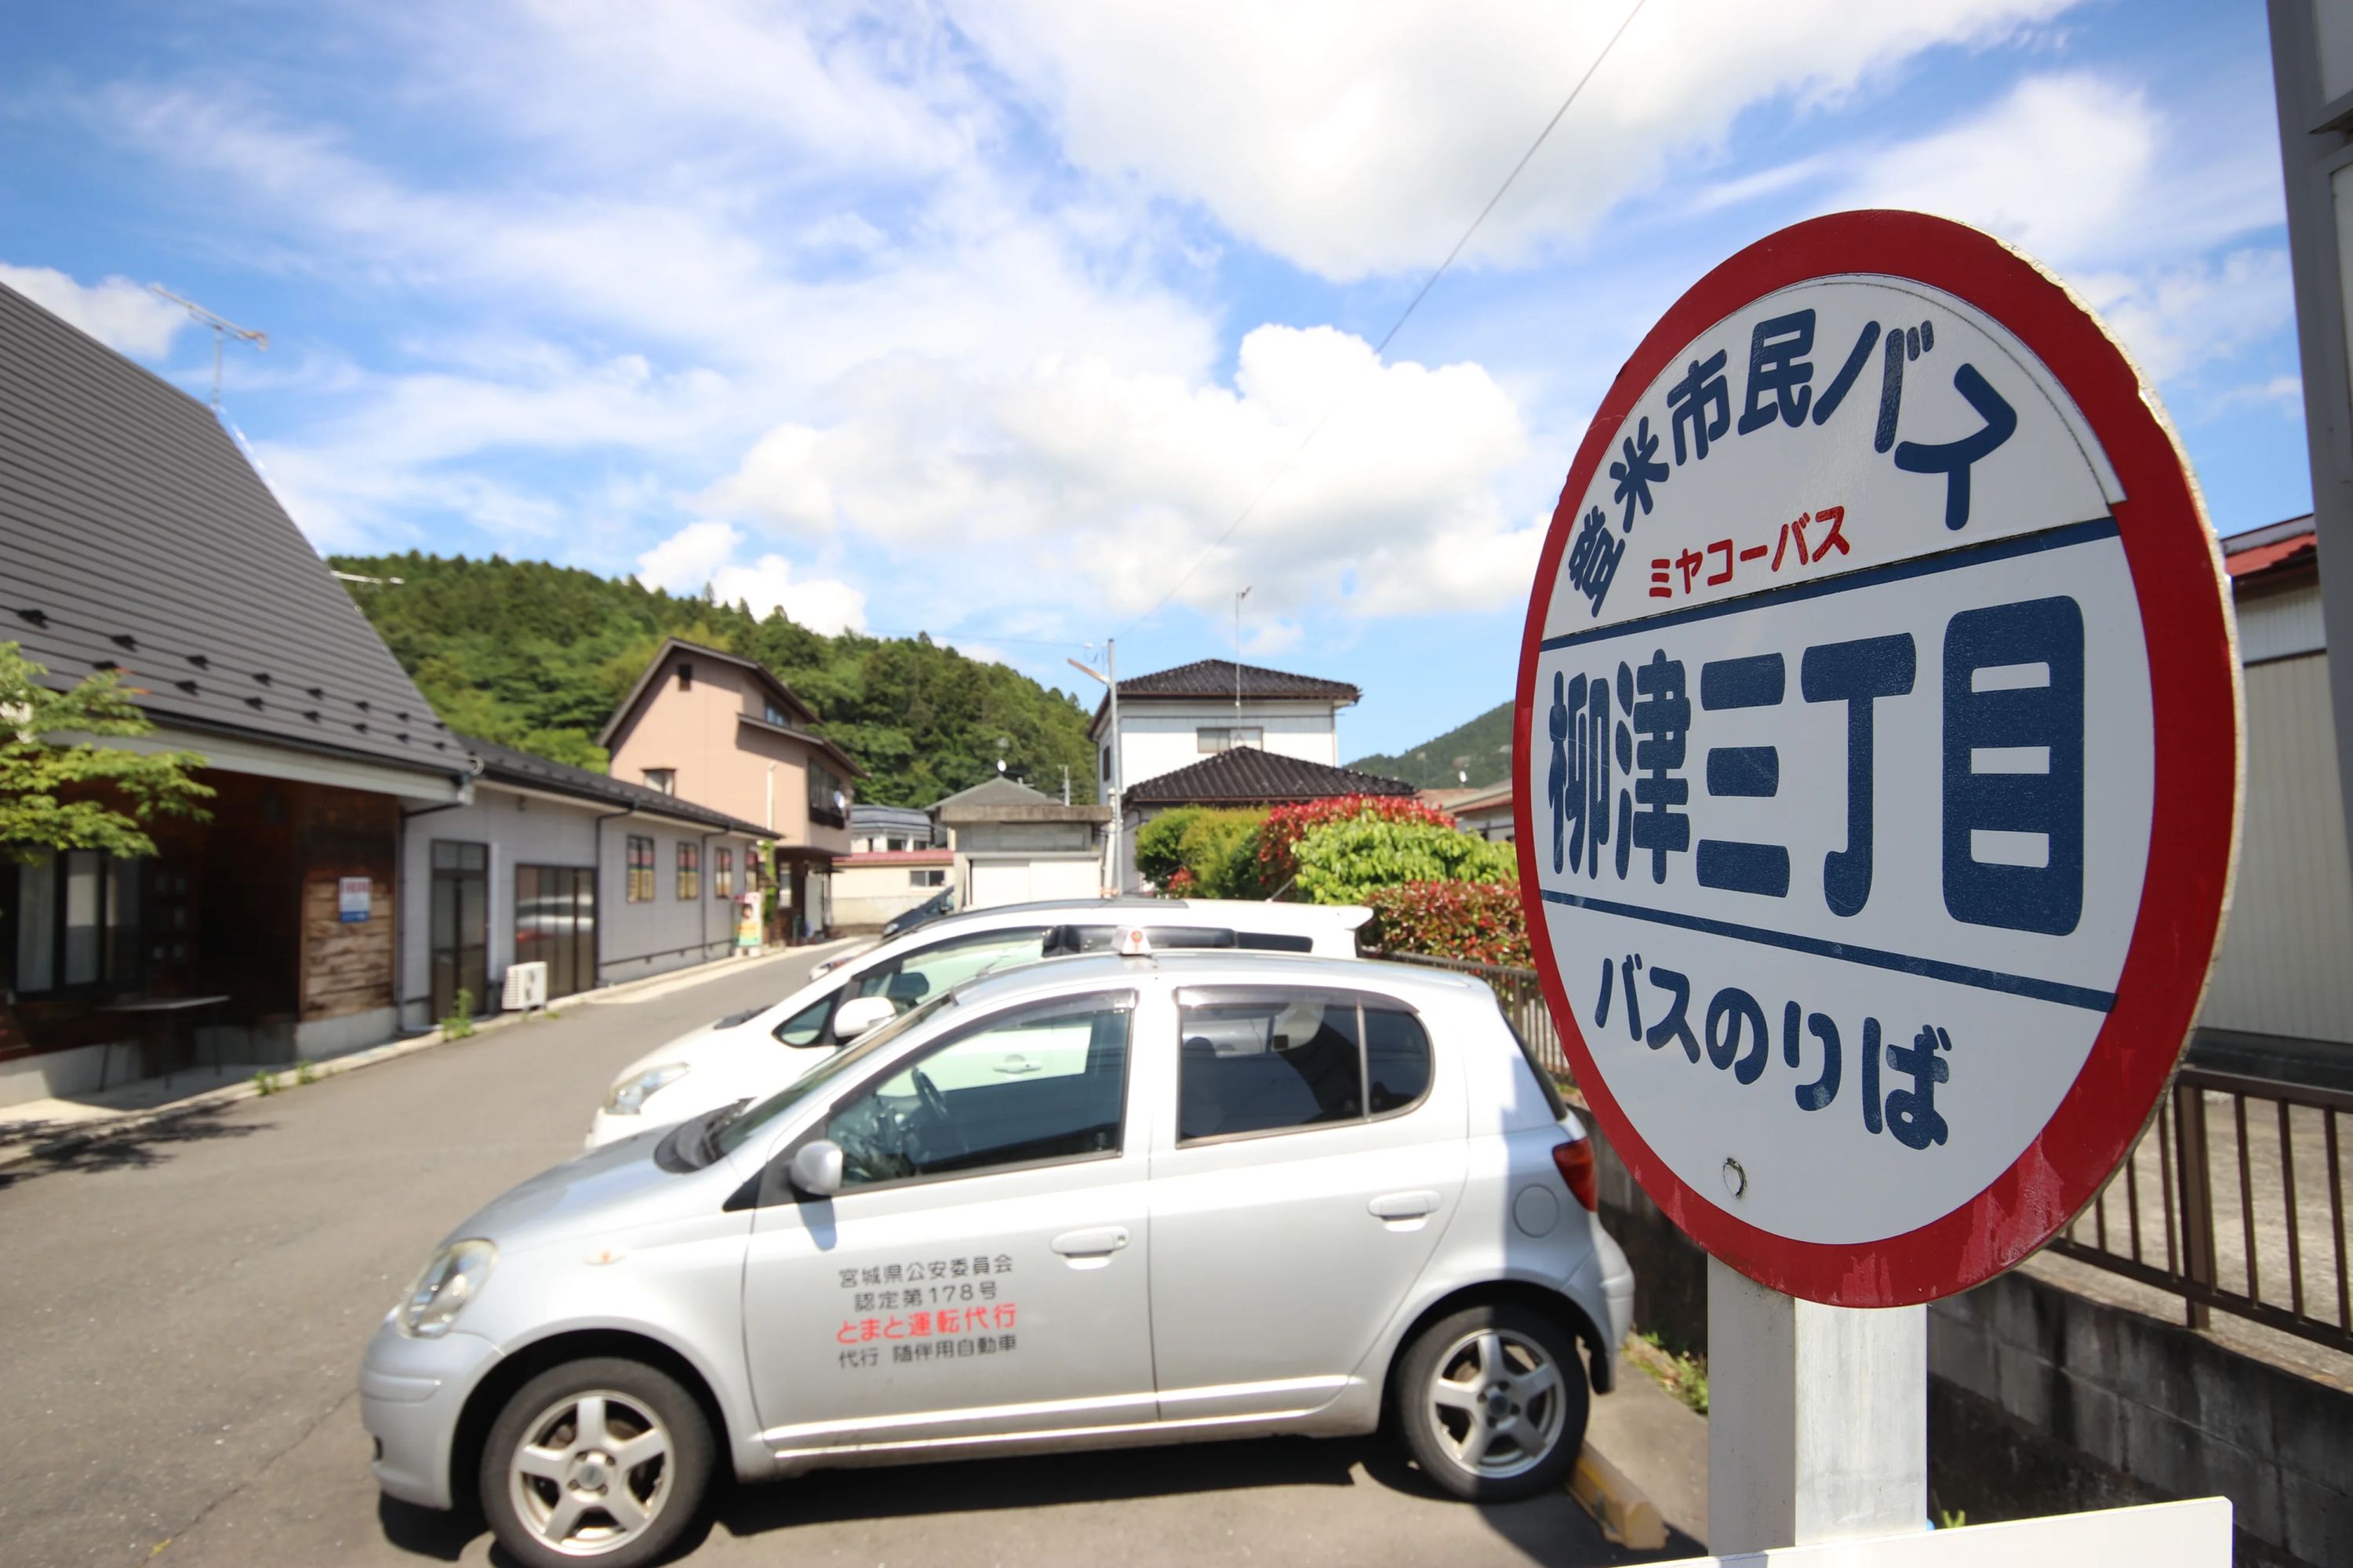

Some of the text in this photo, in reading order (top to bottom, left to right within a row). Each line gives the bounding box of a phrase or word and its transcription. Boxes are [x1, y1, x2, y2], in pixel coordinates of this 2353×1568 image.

[1569, 308, 2017, 617] 登米市民バス
[1649, 506, 1849, 598] ミヤコーバス
[1548, 595, 2085, 936] 柳津三丁目
[1595, 953, 1951, 1150] バスのりば
[838, 1253, 1013, 1288] 宮城県公安委員会
[854, 1281, 998, 1312] 認定第178号
[836, 1302, 1017, 1344] とまと運転代行
[838, 1348, 879, 1370] 代行
